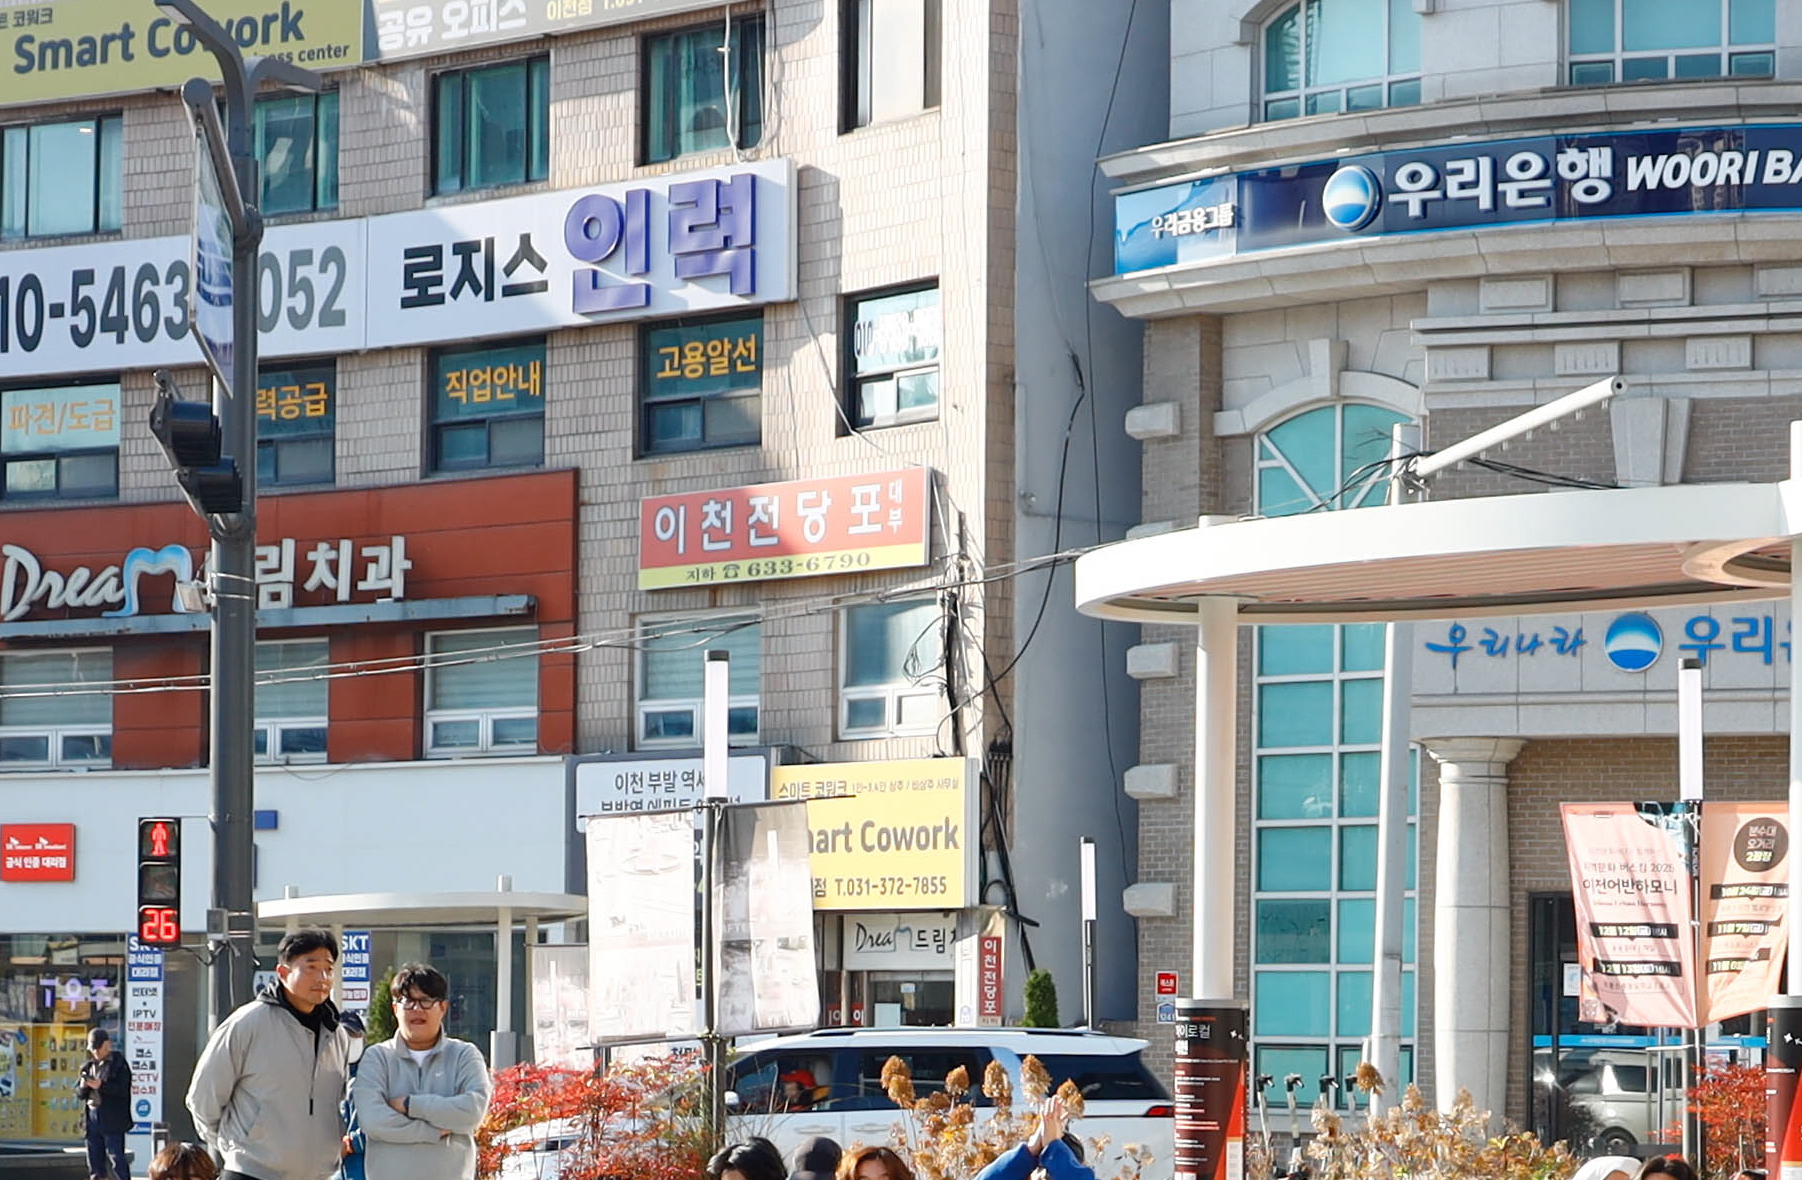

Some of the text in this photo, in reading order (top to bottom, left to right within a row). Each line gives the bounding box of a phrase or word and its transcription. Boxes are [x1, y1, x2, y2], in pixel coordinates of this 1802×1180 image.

[378, 5, 432, 51] 공유
[13, 22, 135, 74] Smart
[298, 43, 350, 64] center
[1387, 146, 1613, 220] 우리은행
[1626, 149, 1760, 193] WOORI
[1151, 203, 1234, 238] 우리금융그룹
[400, 172, 757, 316] 로지스 인력
[657, 334, 758, 381] 고용알선
[445, 360, 542, 405] 직업안내
[9, 401, 115, 434] 파견/도급
[255, 382, 329, 421] 력공급
[653, 479, 903, 555] 이천전당포 대부
[204, 535, 413, 609] 림치과
[686, 552, 871, 582] 지하 633-6790
[1425, 621, 1587, 668] 우리나라
[615, 769, 678, 795] 이천 부발
[861, 817, 960, 853] Cowork
[5, 856, 67, 869] 공식 인증 대리점
[835, 876, 947, 897] T.031-372-7855
[142, 908, 178, 942] 26
[342, 935, 369, 951] SKT
[983, 939, 999, 1014] 이천전당포
[132, 1009, 157, 1019] IPTV
